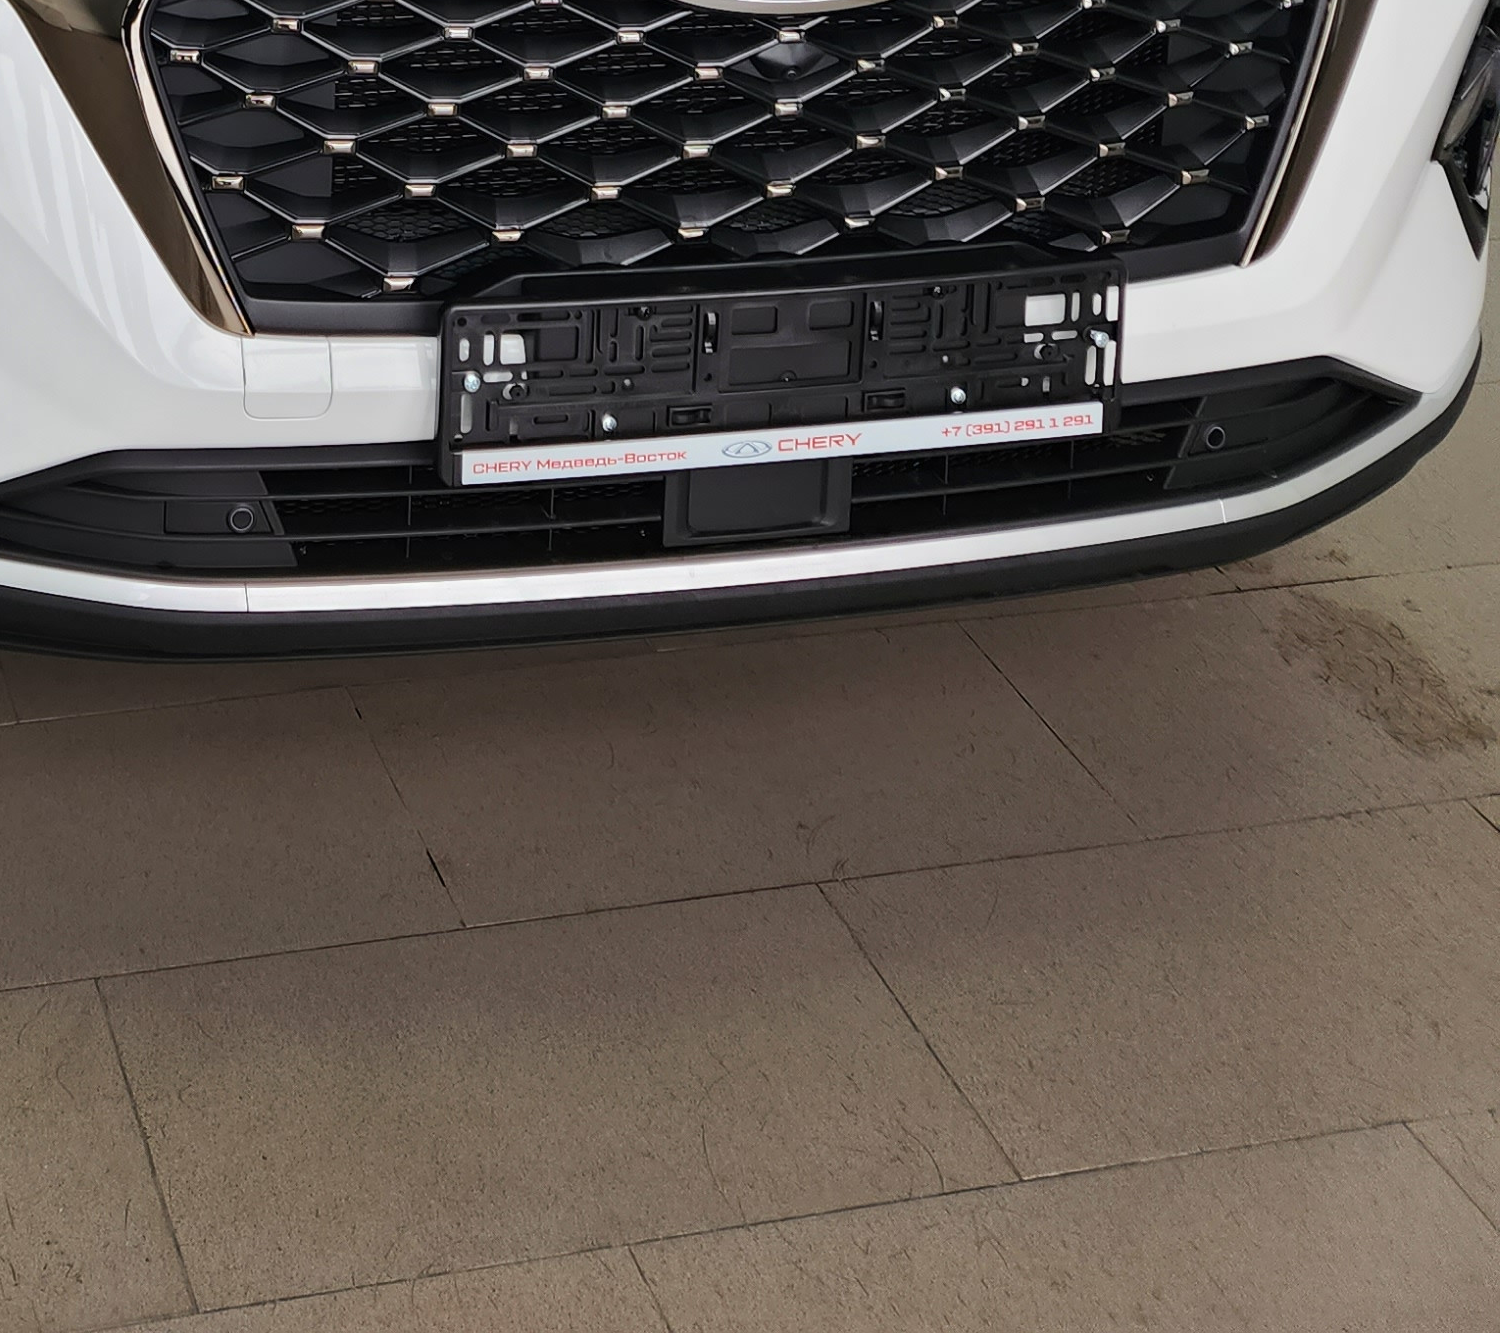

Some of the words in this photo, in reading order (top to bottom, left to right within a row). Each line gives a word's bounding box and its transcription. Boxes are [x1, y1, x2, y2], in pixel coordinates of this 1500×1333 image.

[941, 424, 963, 437] +7
[965, 420, 1011, 437] (391)
[1014, 418, 1045, 432] 291
[1049, 416, 1060, 429] 1
[1063, 414, 1094, 428] 291
[776, 432, 863, 453] CHERY
[471, 459, 532, 475] CHERY
[536, 450, 688, 470] Медведь-Восток
